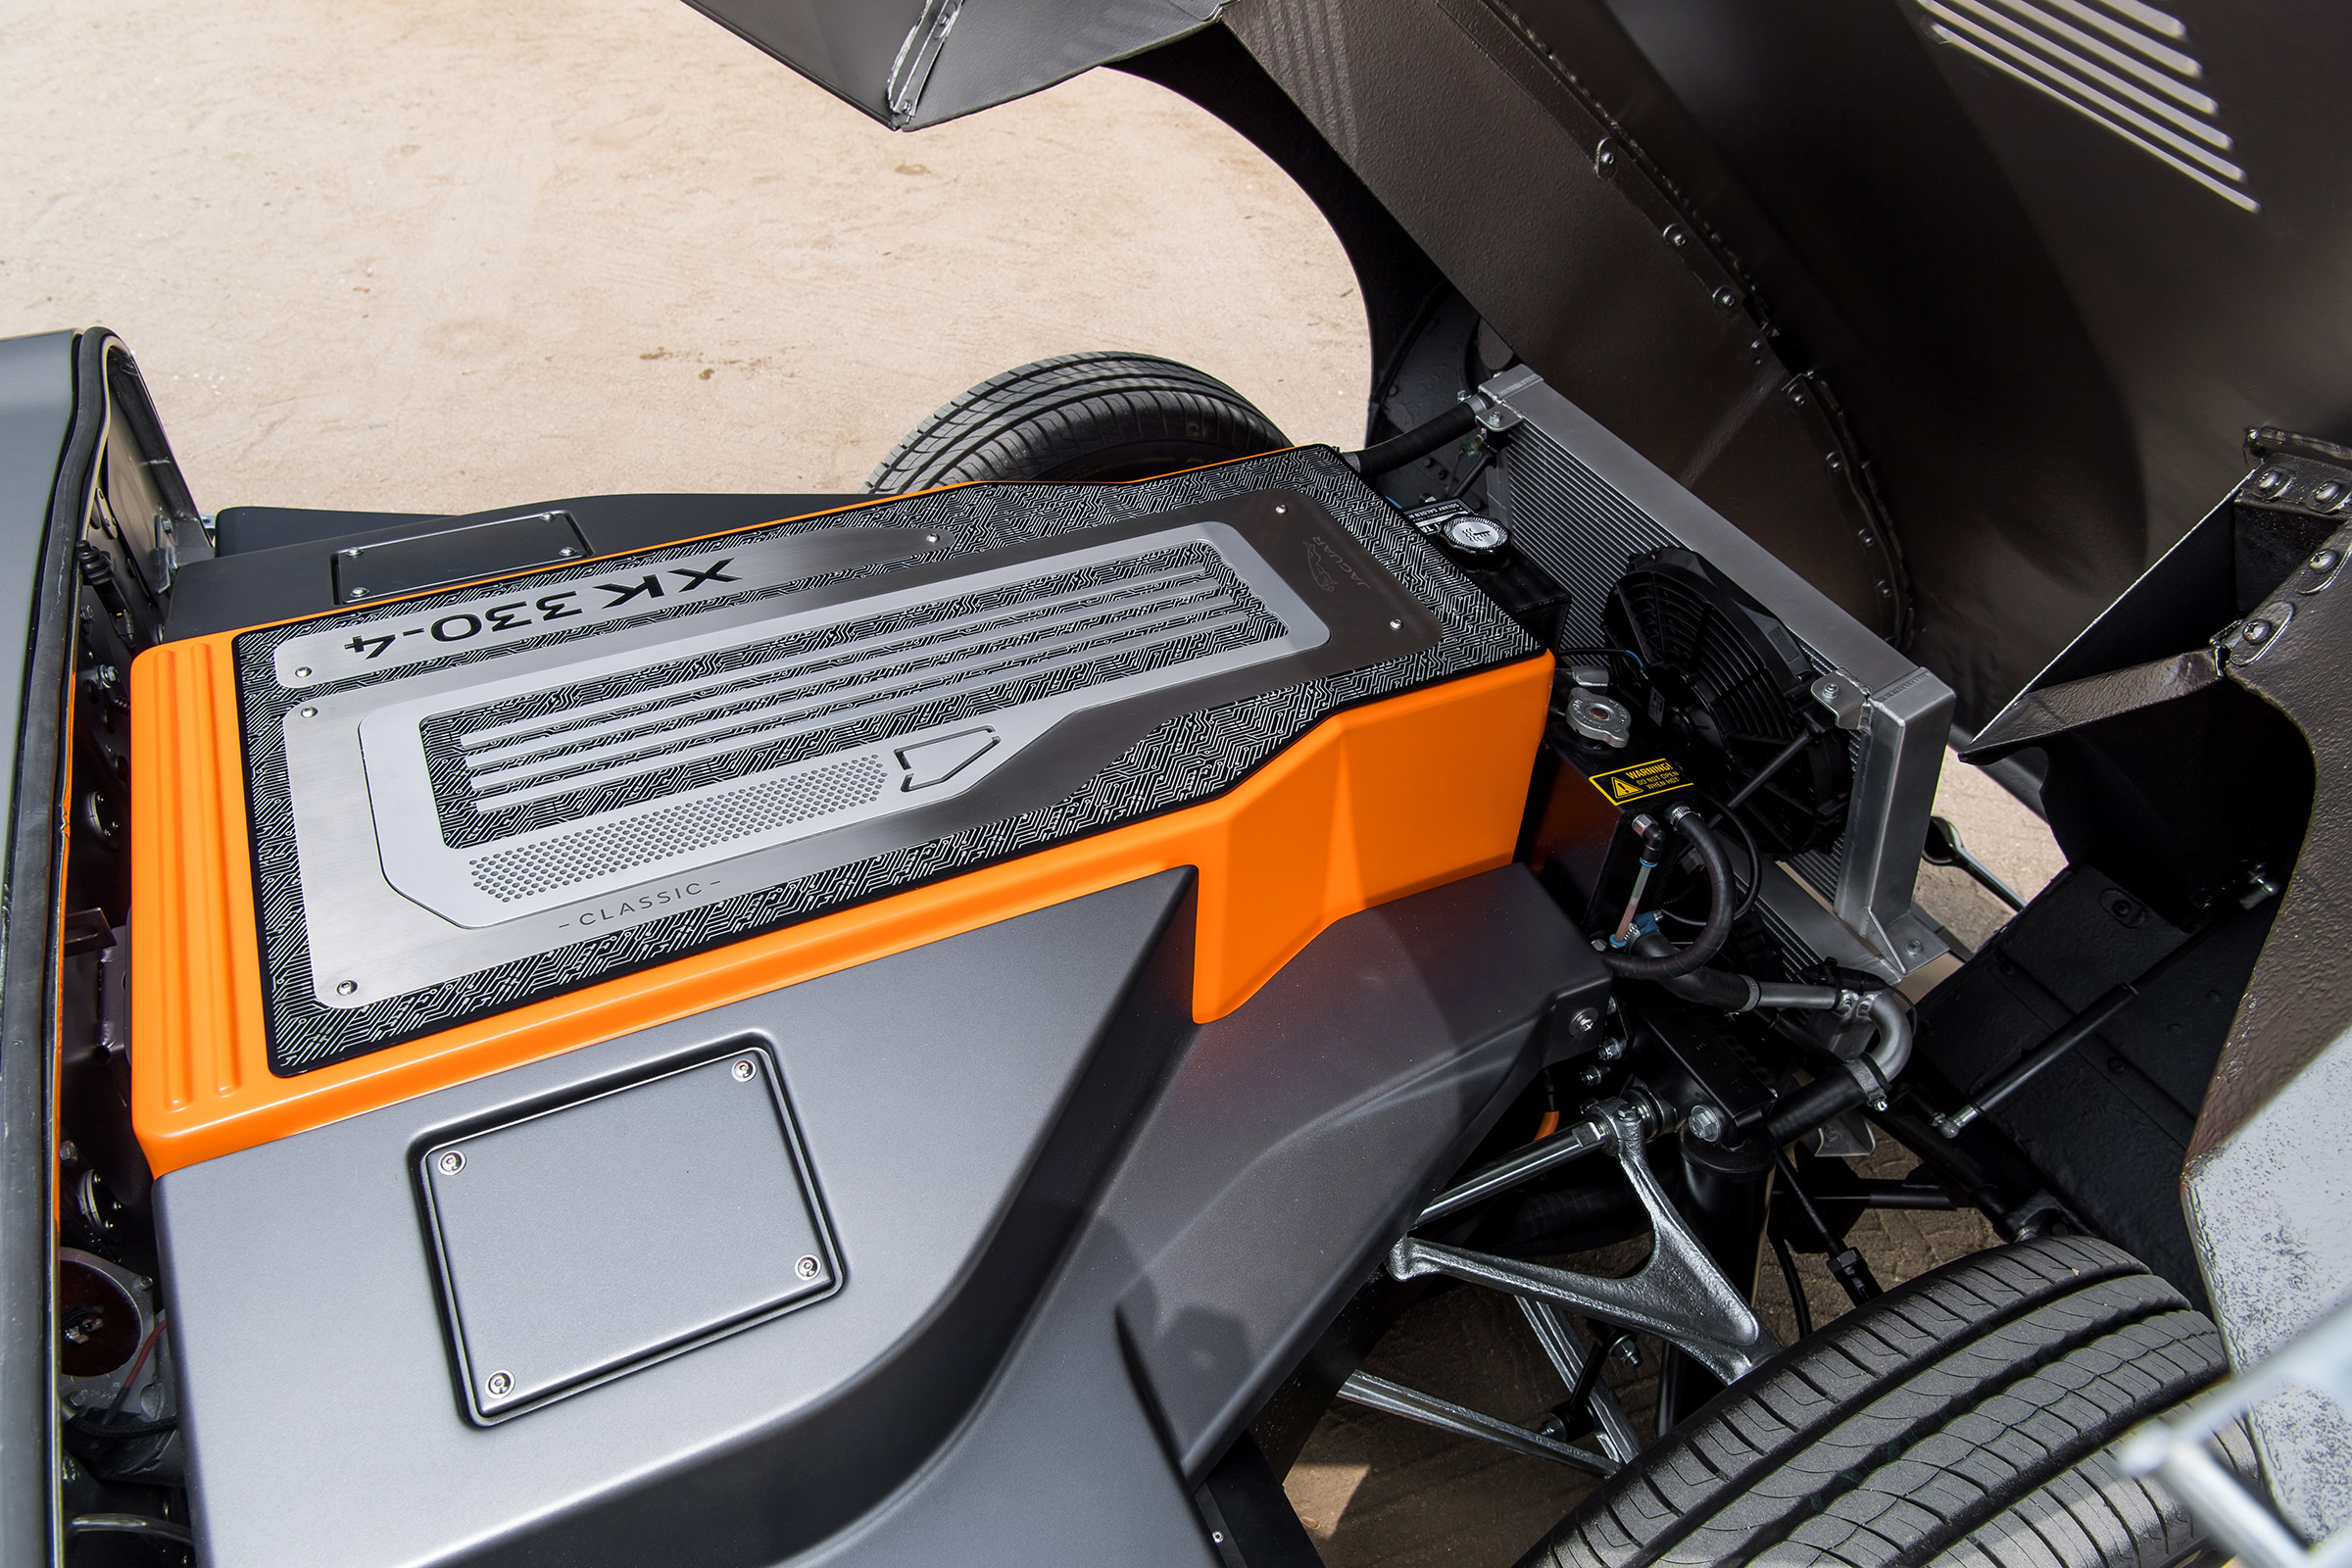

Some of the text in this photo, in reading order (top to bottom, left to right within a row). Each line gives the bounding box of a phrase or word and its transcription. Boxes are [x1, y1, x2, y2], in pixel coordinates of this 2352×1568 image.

[1414, 508, 1438, 517] GALDEN
[1439, 503, 1459, 512] SOLVAY
[1312, 535, 1372, 590] JAGUAR
[344, 558, 743, 661] XK 330-4
[1626, 762, 1673, 779] WARNING!
[1646, 774, 1661, 783] NOT
[1660, 770, 1680, 780] OPEN
[1645, 776, 1680, 790] WHEN HOT
[579, 882, 703, 926] CLASSIC
